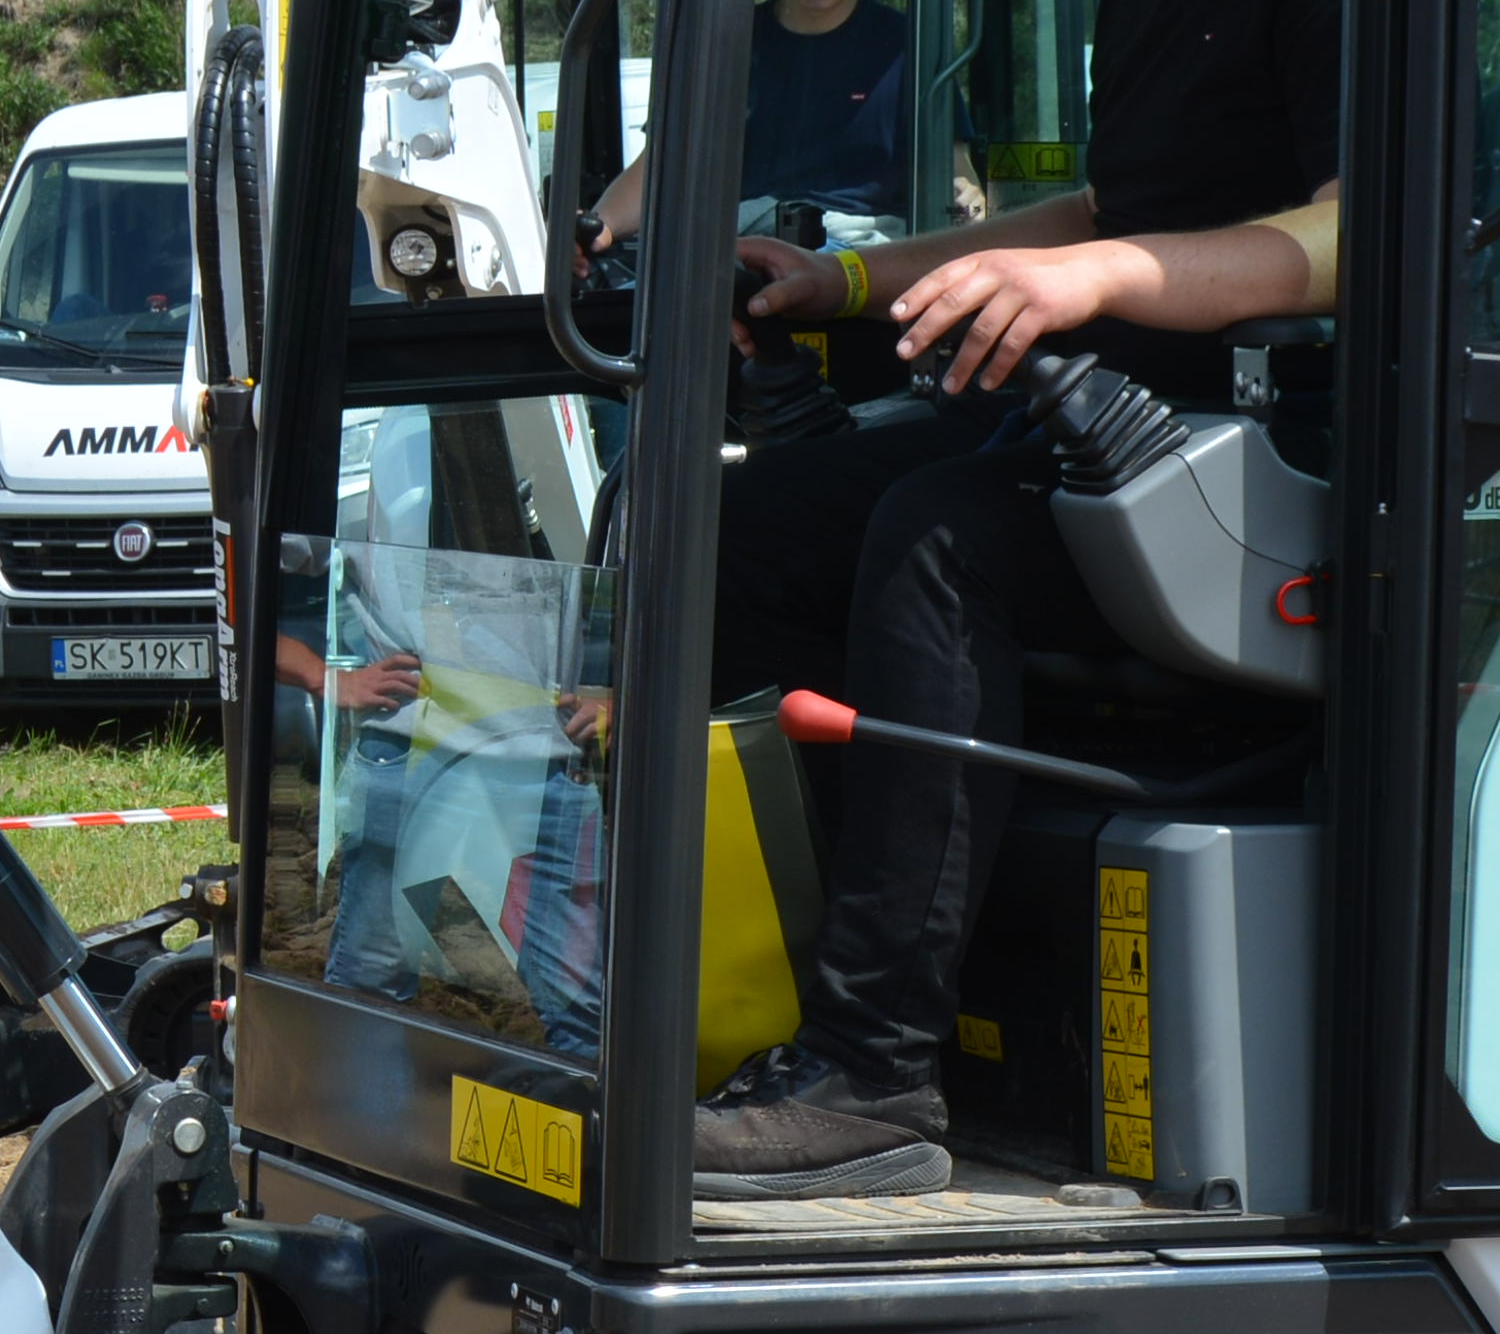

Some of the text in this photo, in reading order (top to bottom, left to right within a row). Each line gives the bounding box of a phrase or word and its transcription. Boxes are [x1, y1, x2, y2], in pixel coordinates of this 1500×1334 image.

[43, 425, 199, 457] AMMA
[121, 534, 143, 552] FIAT
[70, 642, 204, 670] SK 519KT
